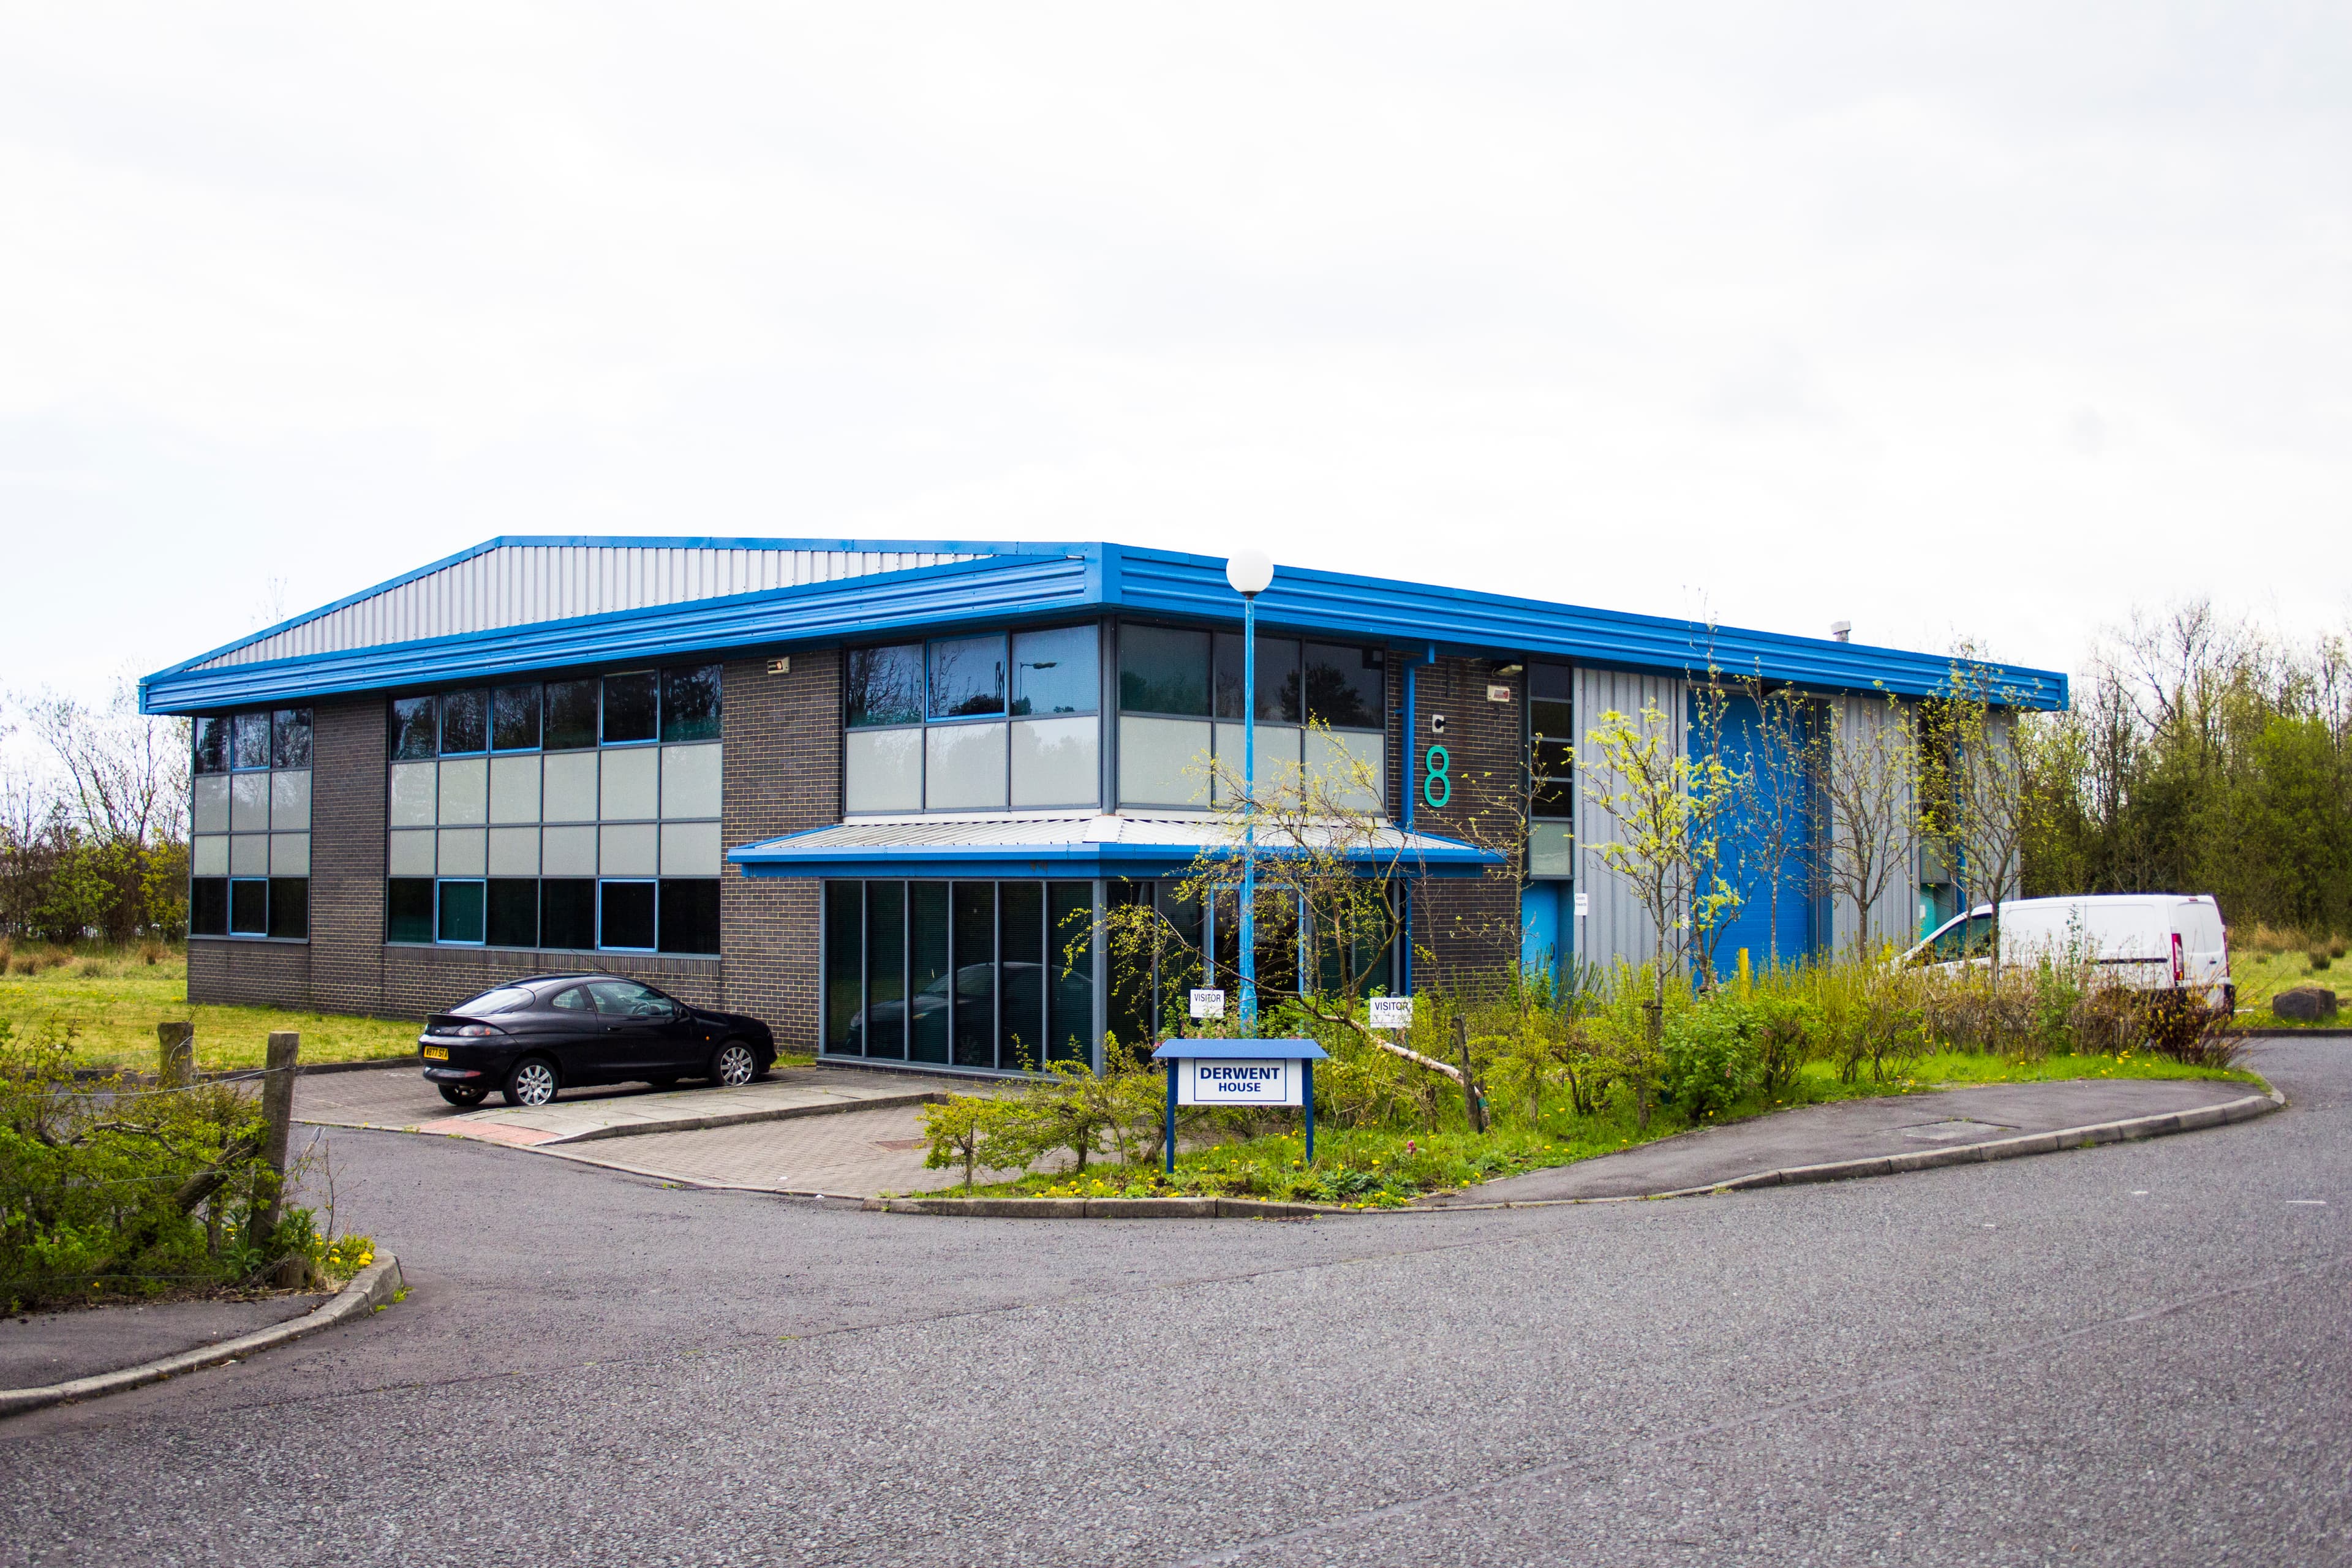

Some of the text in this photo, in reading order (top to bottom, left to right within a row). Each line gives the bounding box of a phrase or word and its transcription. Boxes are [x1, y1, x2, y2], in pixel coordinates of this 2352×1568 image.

[1424, 745, 1450, 807] 8
[1194, 993, 1221, 1003] VISITOR
[1374, 1001, 1408, 1011] VISITOR
[1200, 1067, 1280, 1079] DERWENT
[1218, 1082, 1261, 1091] HOUSE
